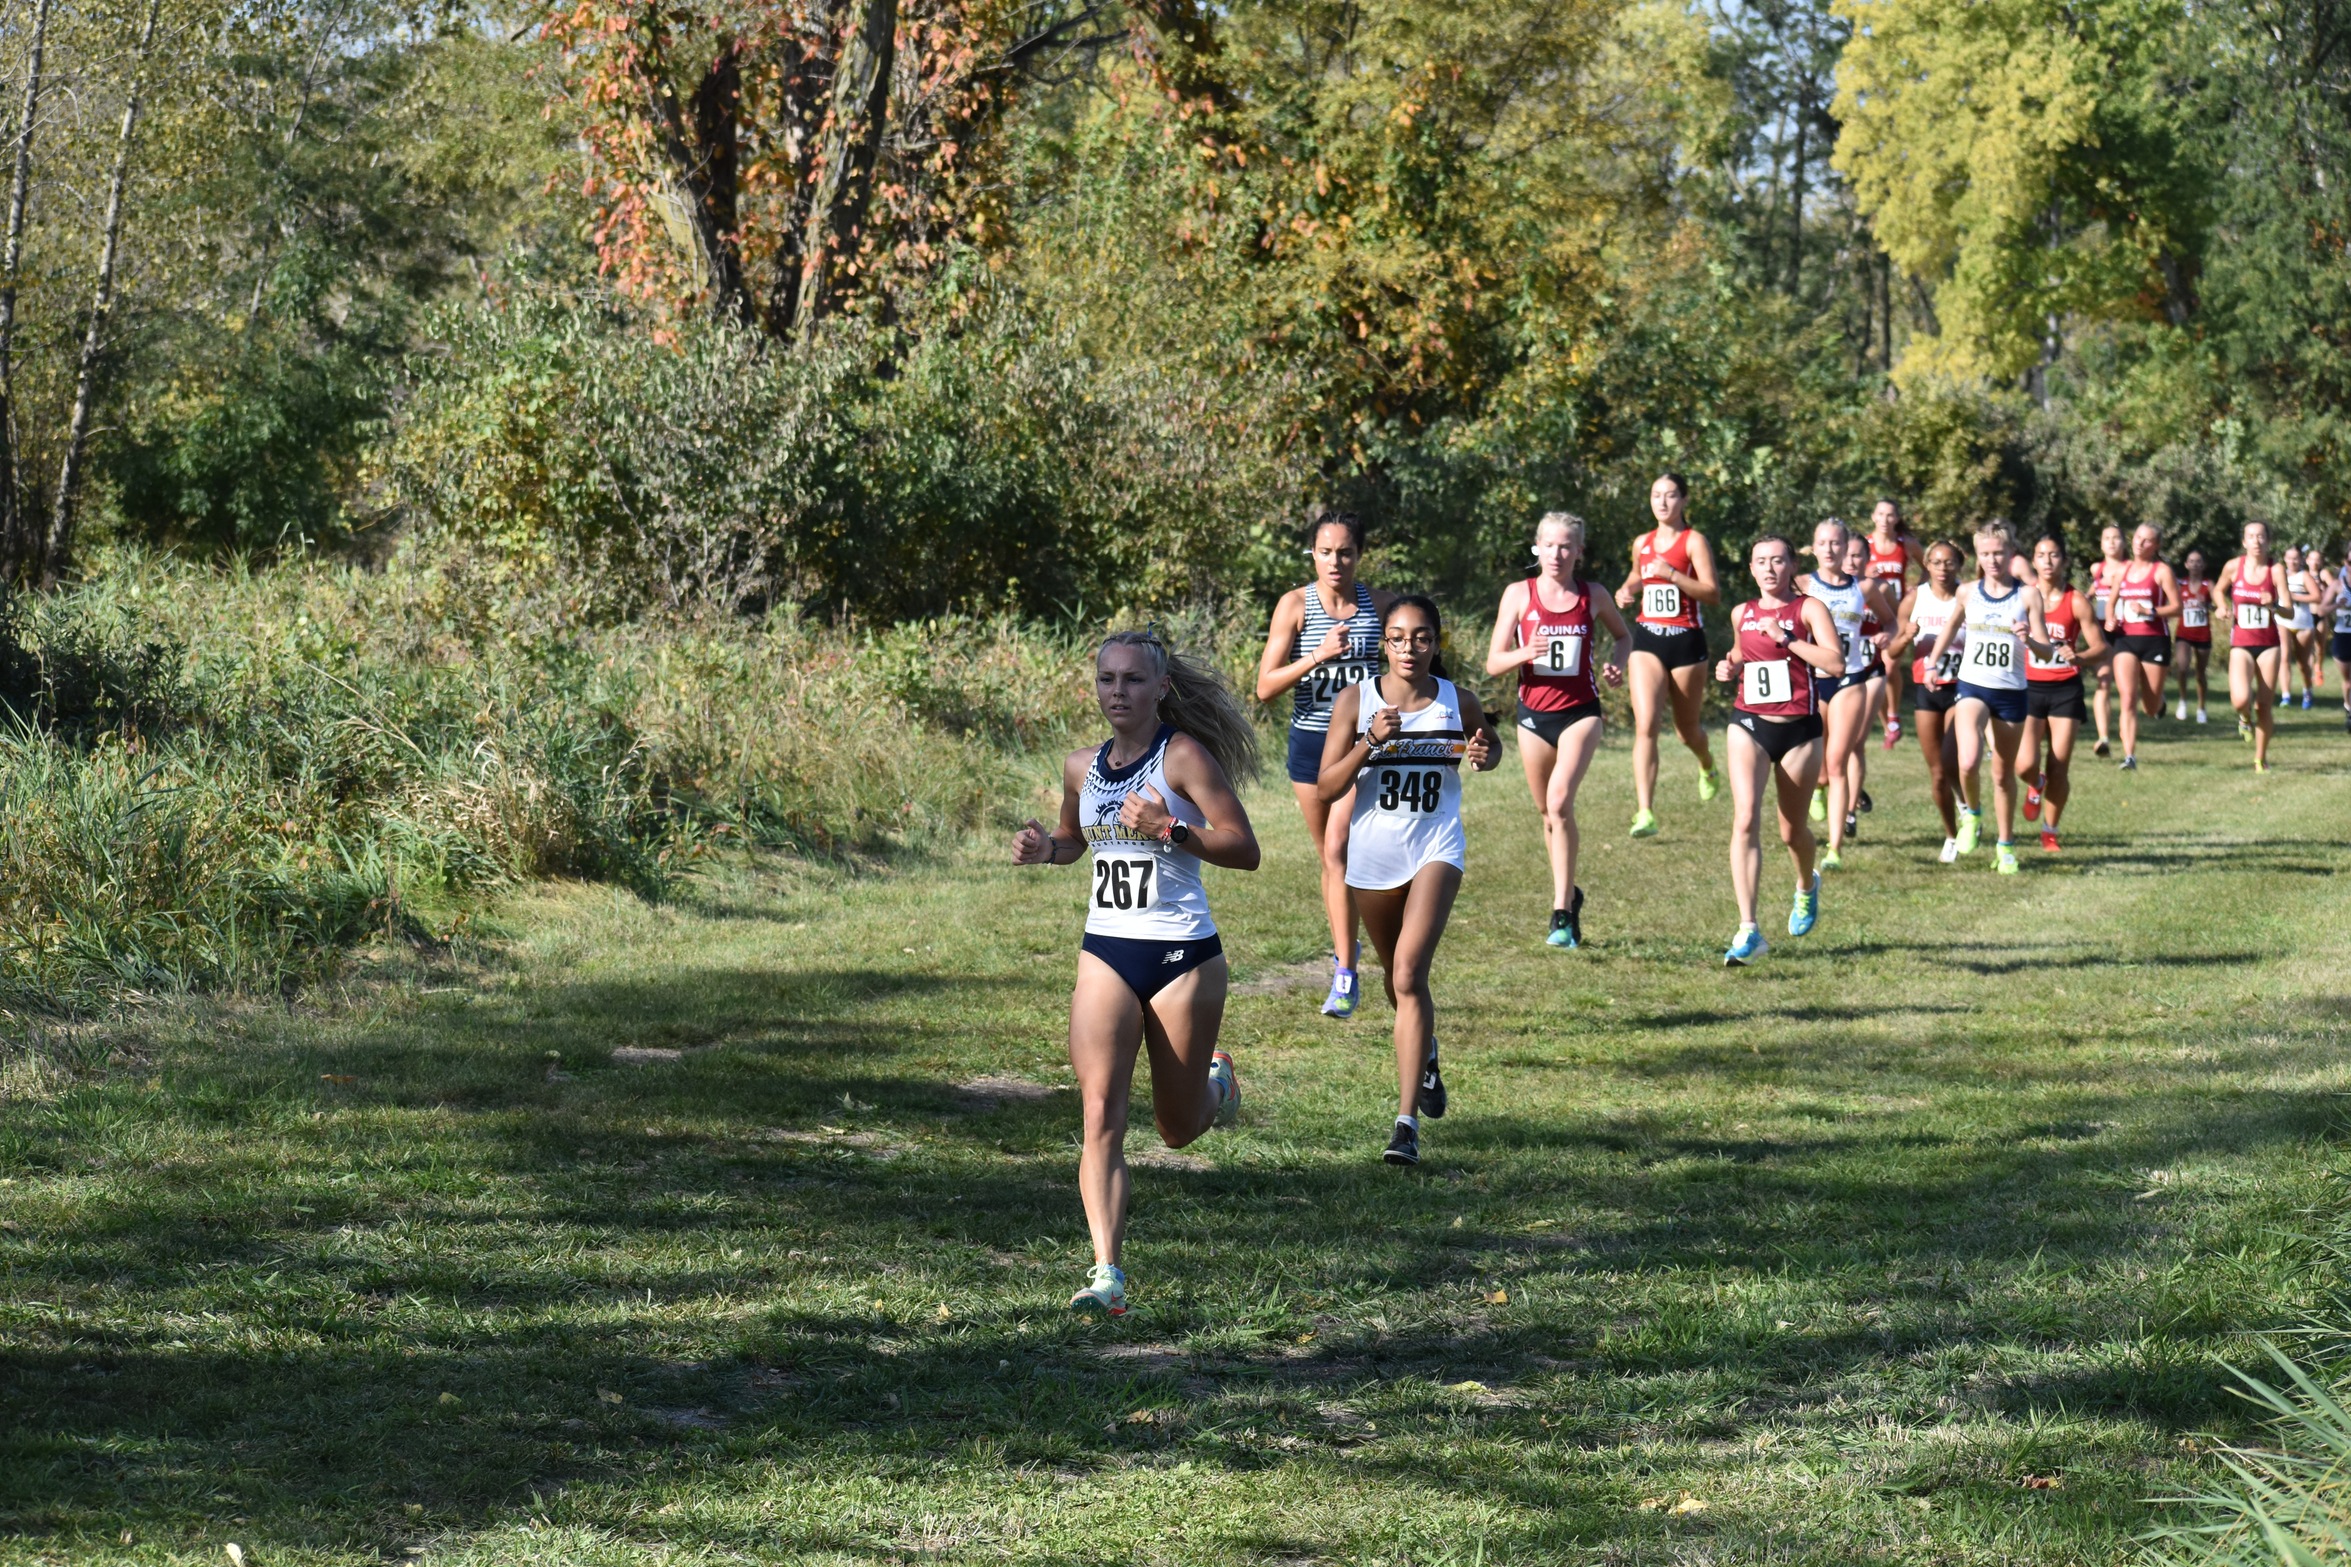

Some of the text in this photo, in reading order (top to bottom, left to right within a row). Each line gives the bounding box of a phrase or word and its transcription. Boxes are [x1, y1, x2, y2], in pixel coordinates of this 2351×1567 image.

[1648, 588, 1676, 612] 166
[2246, 606, 2263, 625] 14
[1537, 624, 1588, 636] QUINAS
[1551, 640, 1565, 672] 6
[1973, 641, 2010, 668] 268
[1757, 666, 1772, 698] 9
[1395, 738, 1455, 758] Francis
[1379, 769, 1442, 813] 348
[1095, 859, 1154, 911] 267
